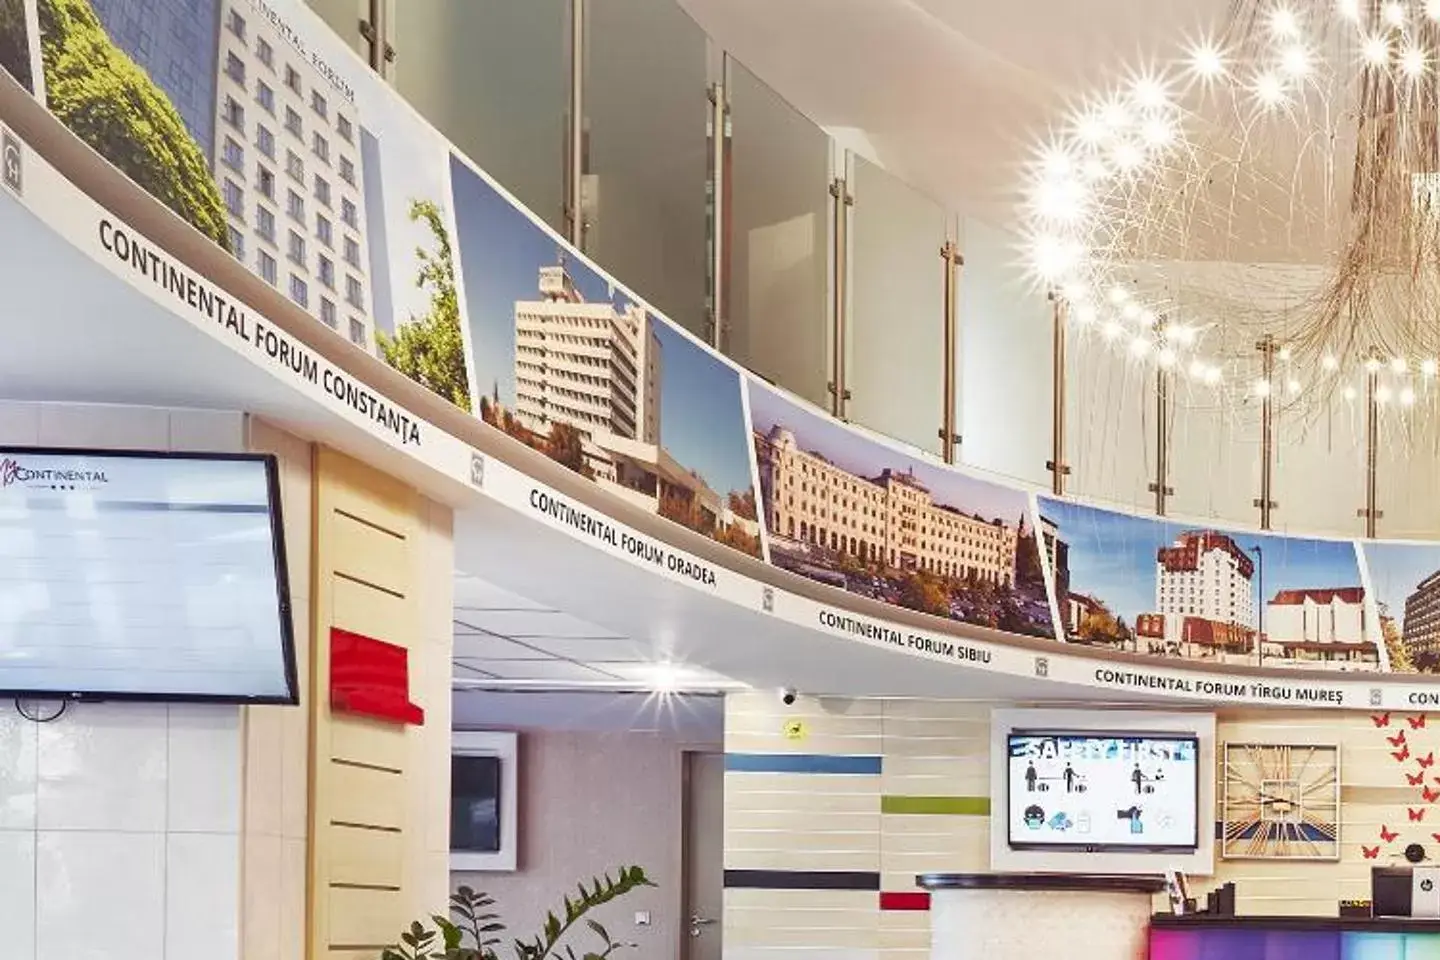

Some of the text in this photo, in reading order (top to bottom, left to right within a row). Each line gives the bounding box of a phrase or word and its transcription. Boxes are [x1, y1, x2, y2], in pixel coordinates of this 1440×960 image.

[99, 219, 421, 446] CONTINENTAL FORUM CONSTANȚA
[529, 488, 718, 587] CONTINENTAL FORUM ORADEA
[819, 610, 992, 664] CONTINENTAL FORUM SIBIU
[1095, 668, 1192, 692] CONTINENTAL
[1195, 680, 1246, 697] FORUM
[1250, 682, 1292, 700] TÎRGU
